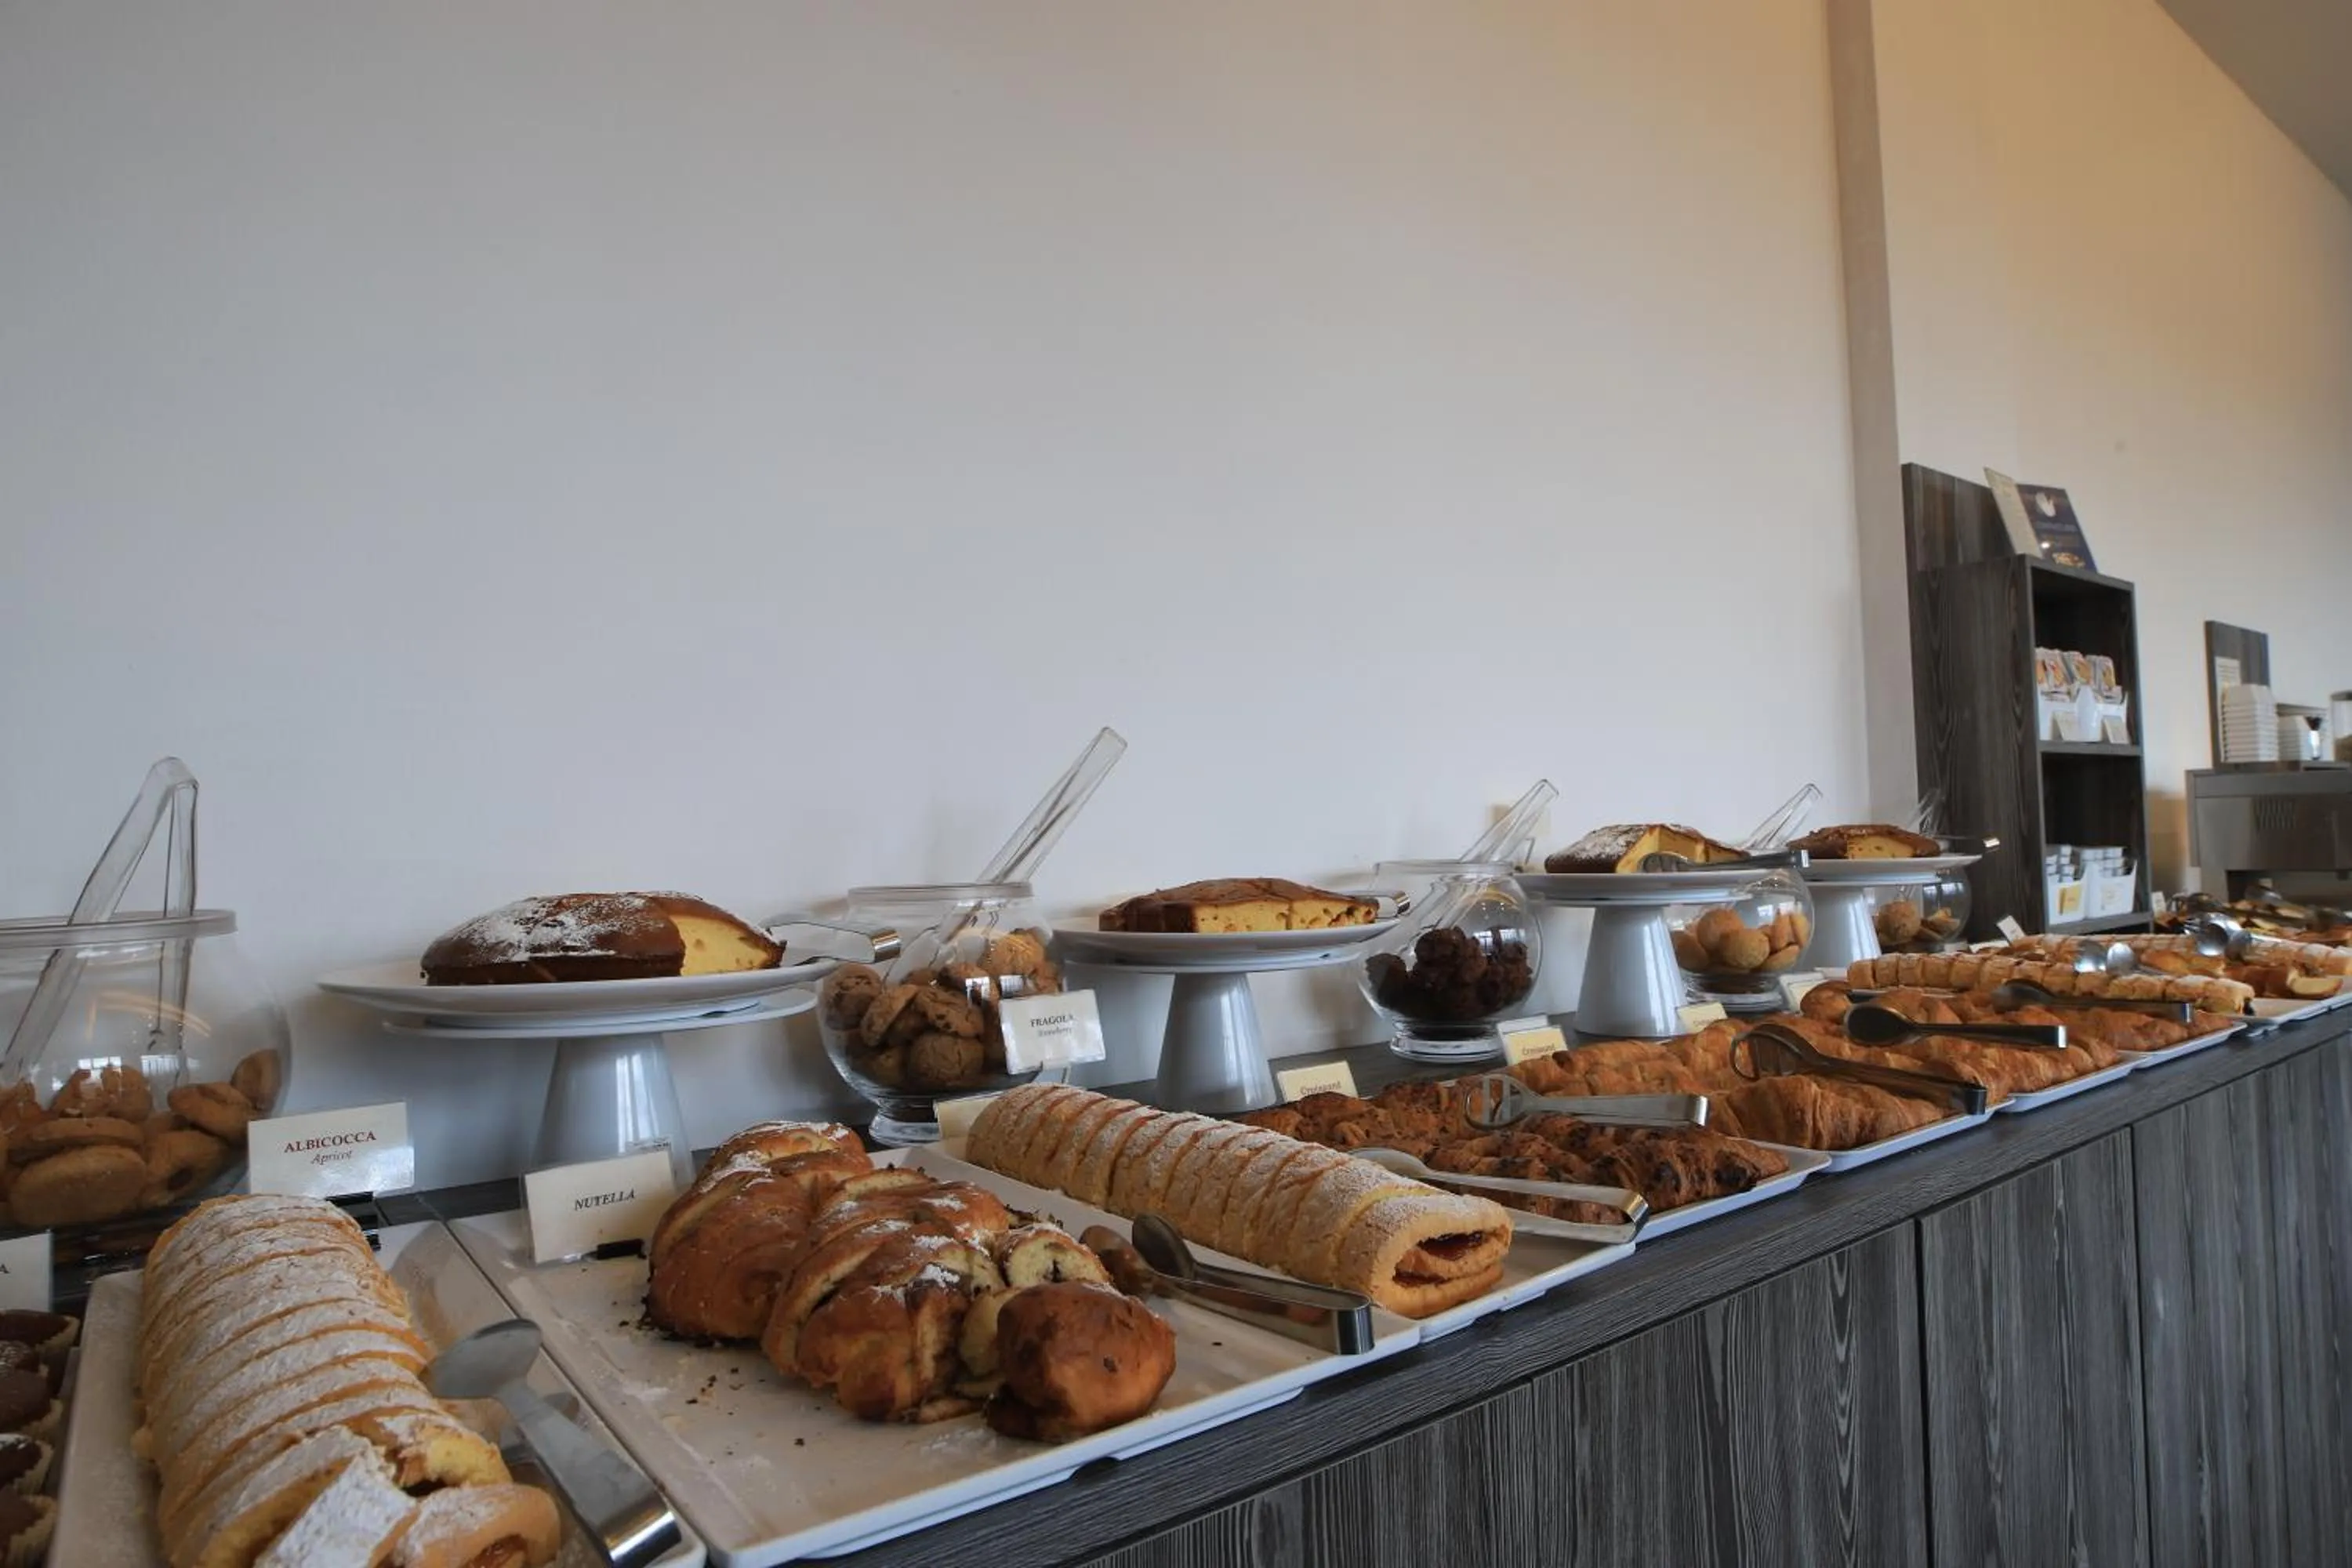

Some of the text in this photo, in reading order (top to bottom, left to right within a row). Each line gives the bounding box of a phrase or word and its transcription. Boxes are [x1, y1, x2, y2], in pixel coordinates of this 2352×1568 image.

[284, 1131, 376, 1152] ALBICOCCA
[310, 1150, 352, 1165] Apricot
[575, 1189, 634, 1210] NUTELLA
